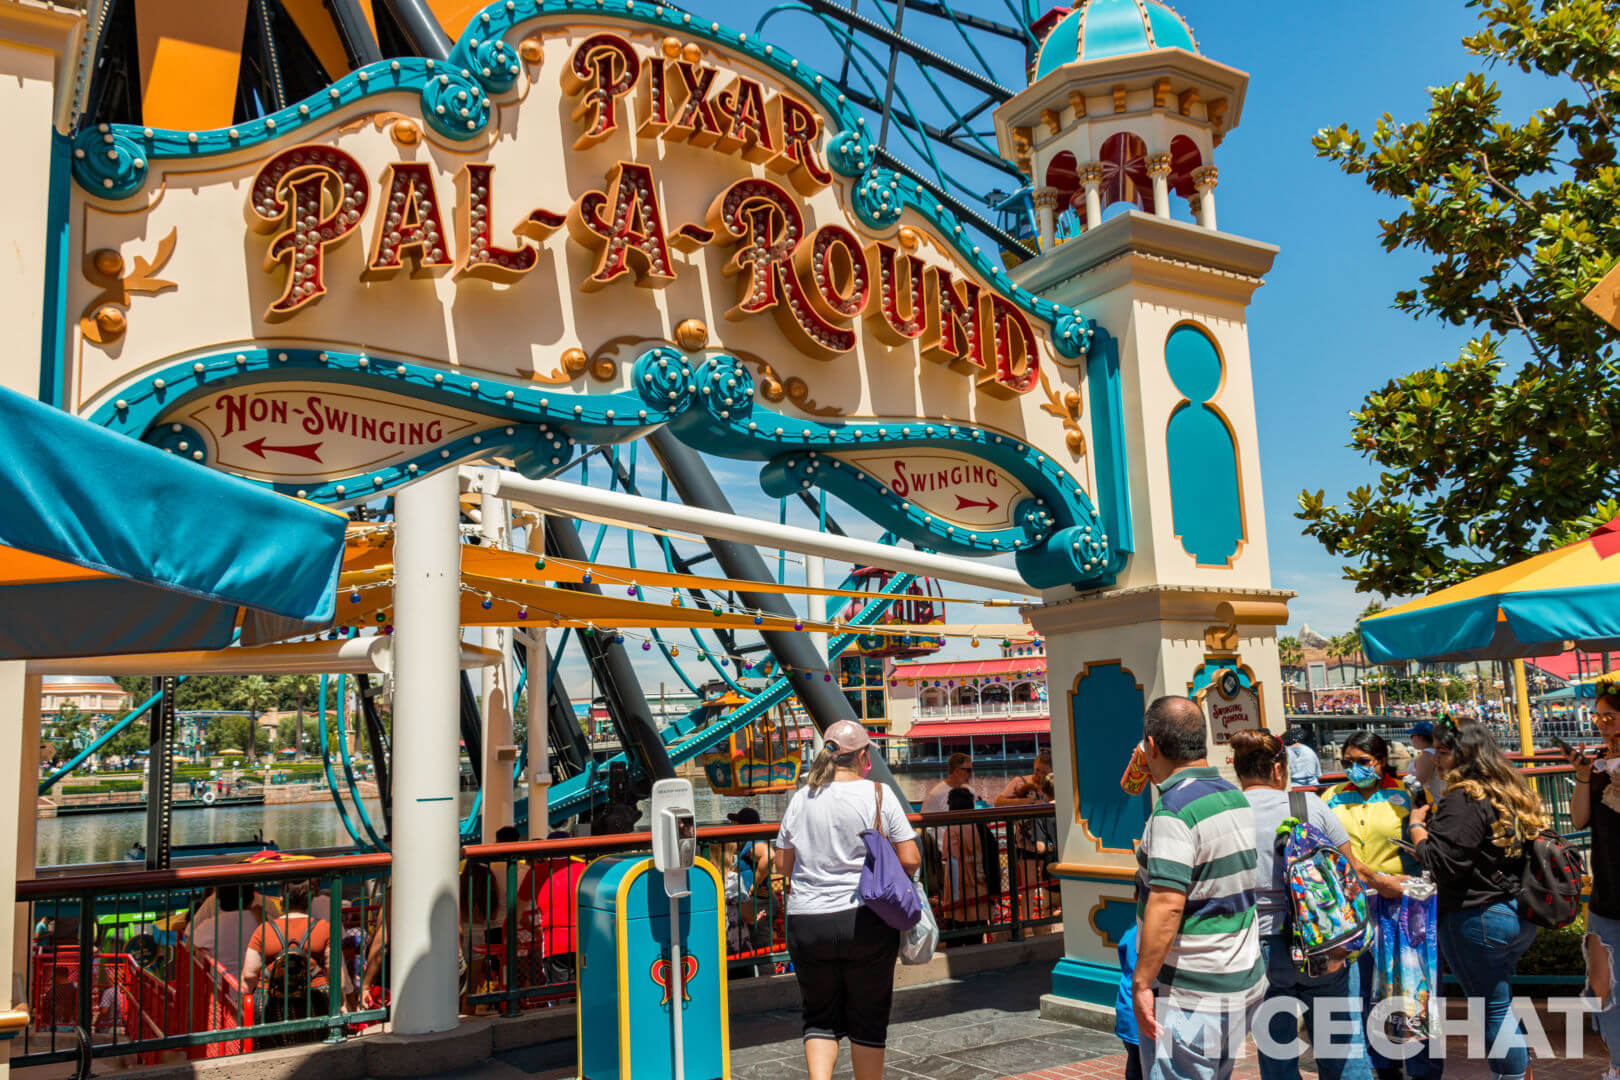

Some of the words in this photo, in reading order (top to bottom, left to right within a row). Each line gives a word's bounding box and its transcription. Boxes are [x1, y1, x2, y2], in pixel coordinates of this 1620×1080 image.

[566, 33, 834, 194] PIXAR
[215, 393, 443, 446] NON-SWINGING
[891, 460, 998, 498] SWINGING
[1212, 703, 1243, 720] SWINGING
